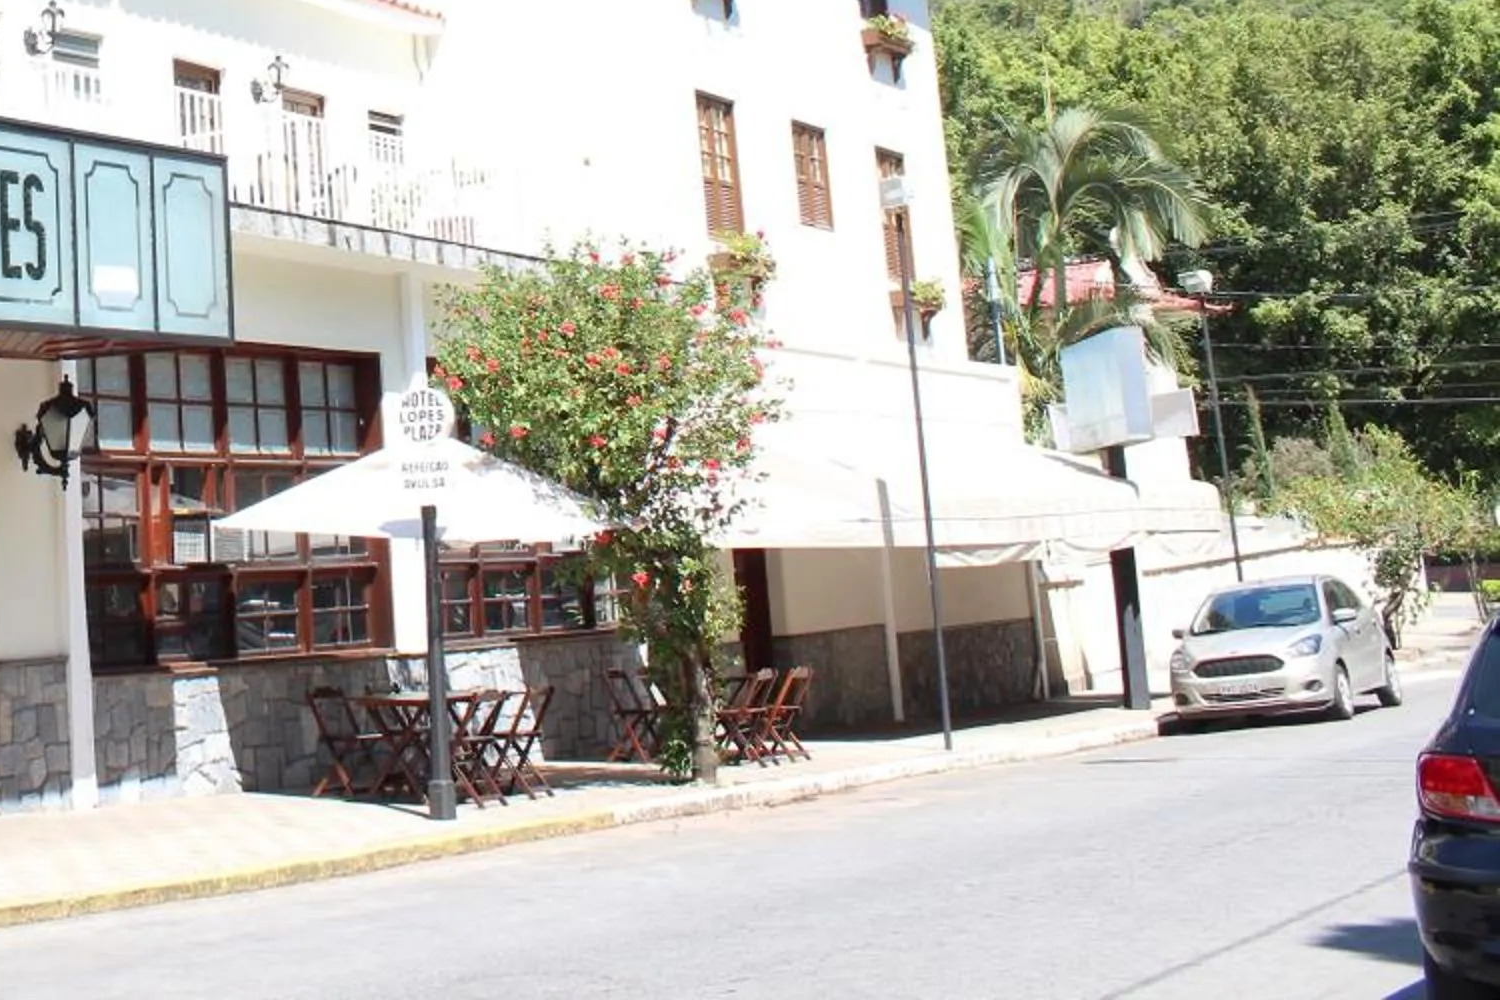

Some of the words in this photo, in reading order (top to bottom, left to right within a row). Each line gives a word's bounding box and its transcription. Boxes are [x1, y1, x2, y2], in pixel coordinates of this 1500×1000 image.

[401, 390, 444, 408] HOTEL
[399, 409, 445, 424] LOPES
[403, 423, 442, 441] PLAZA
